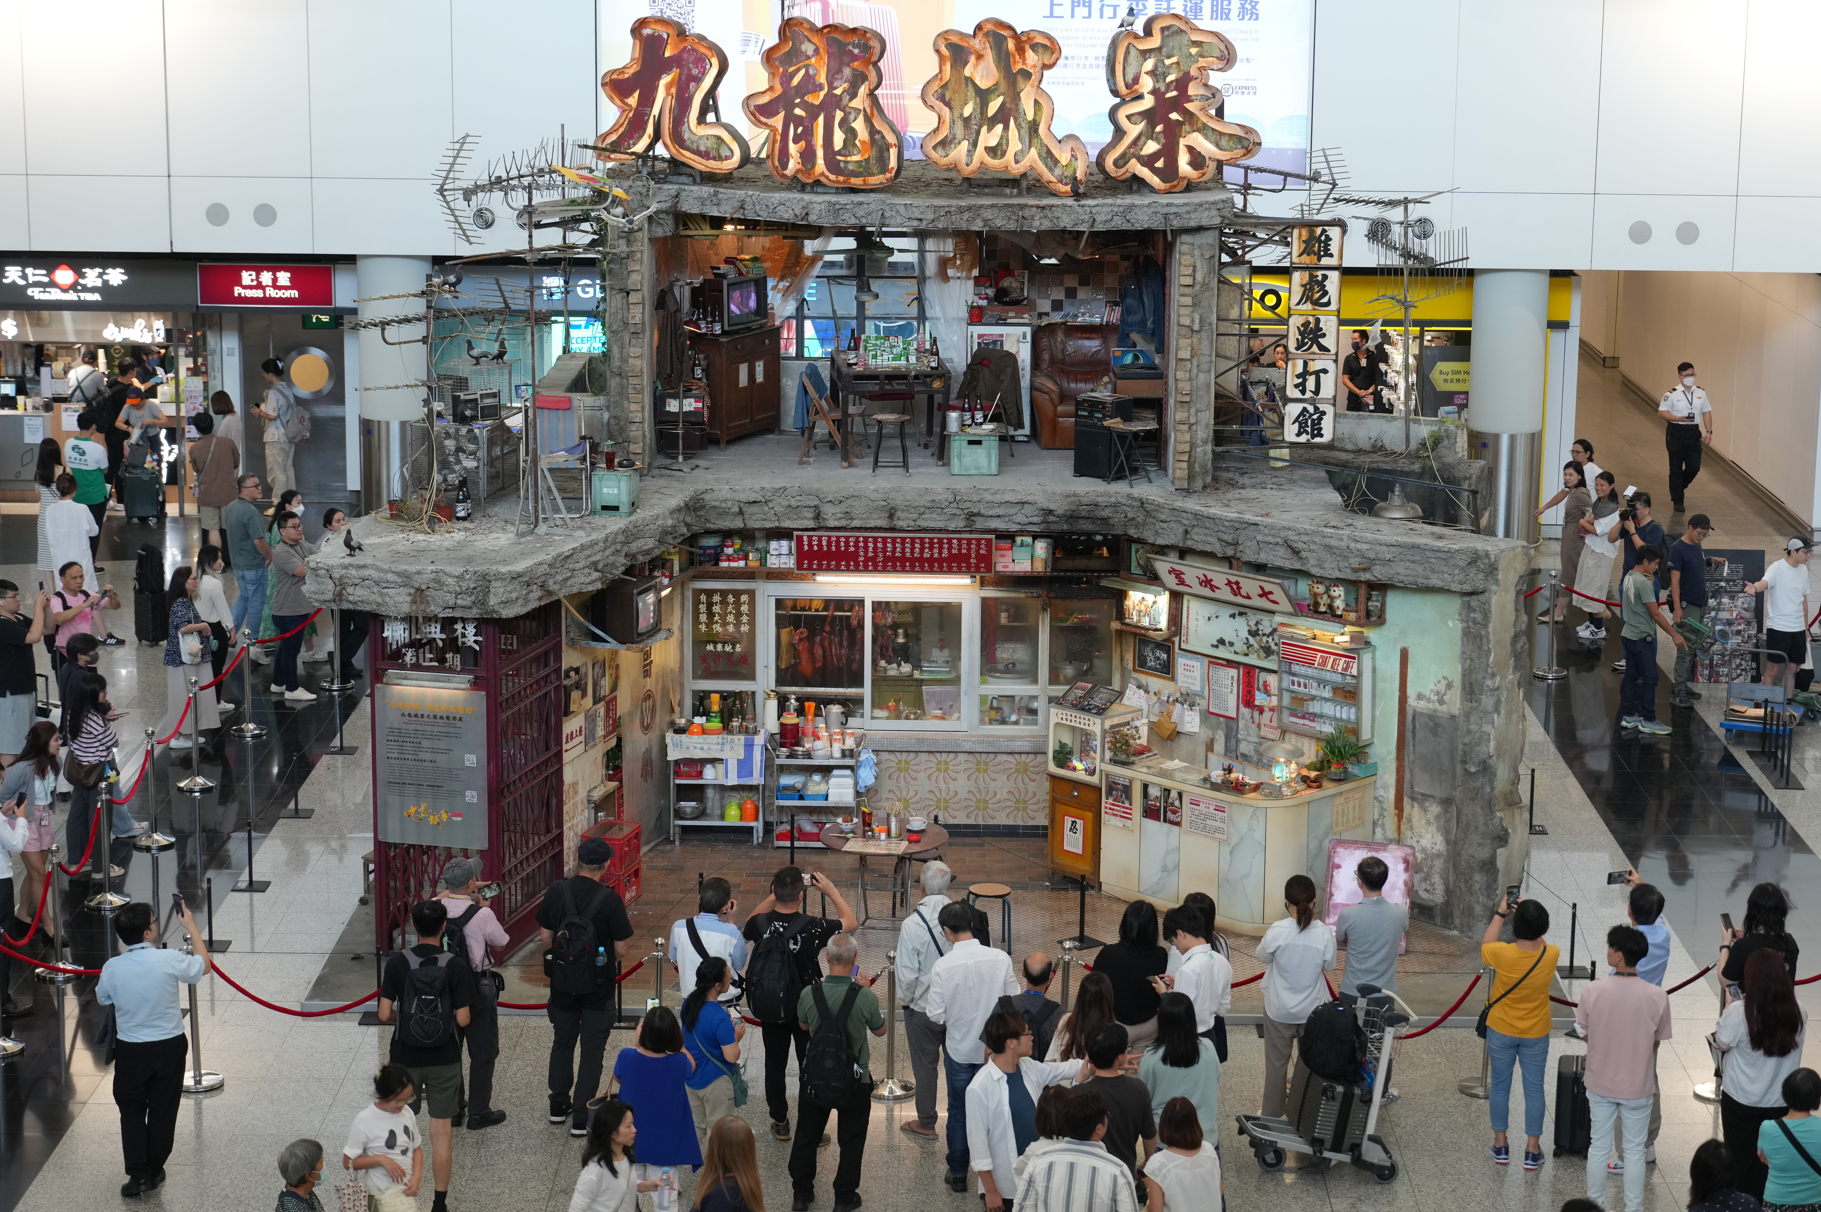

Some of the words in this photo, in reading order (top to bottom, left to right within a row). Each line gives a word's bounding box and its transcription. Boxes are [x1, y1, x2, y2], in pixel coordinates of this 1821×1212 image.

[601, 15, 1262, 196] 九龍城寨
[2, 266, 50, 286] 天仁
[78, 268, 128, 288] 茗茶
[241, 270, 292, 286] 記者室
[234, 286, 264, 298] Press
[266, 287, 298, 298] Room
[1330, 657, 1342, 672] KEE
[1341, 659, 1356, 674] CAFE
[1268, 708, 1276, 724] 7
